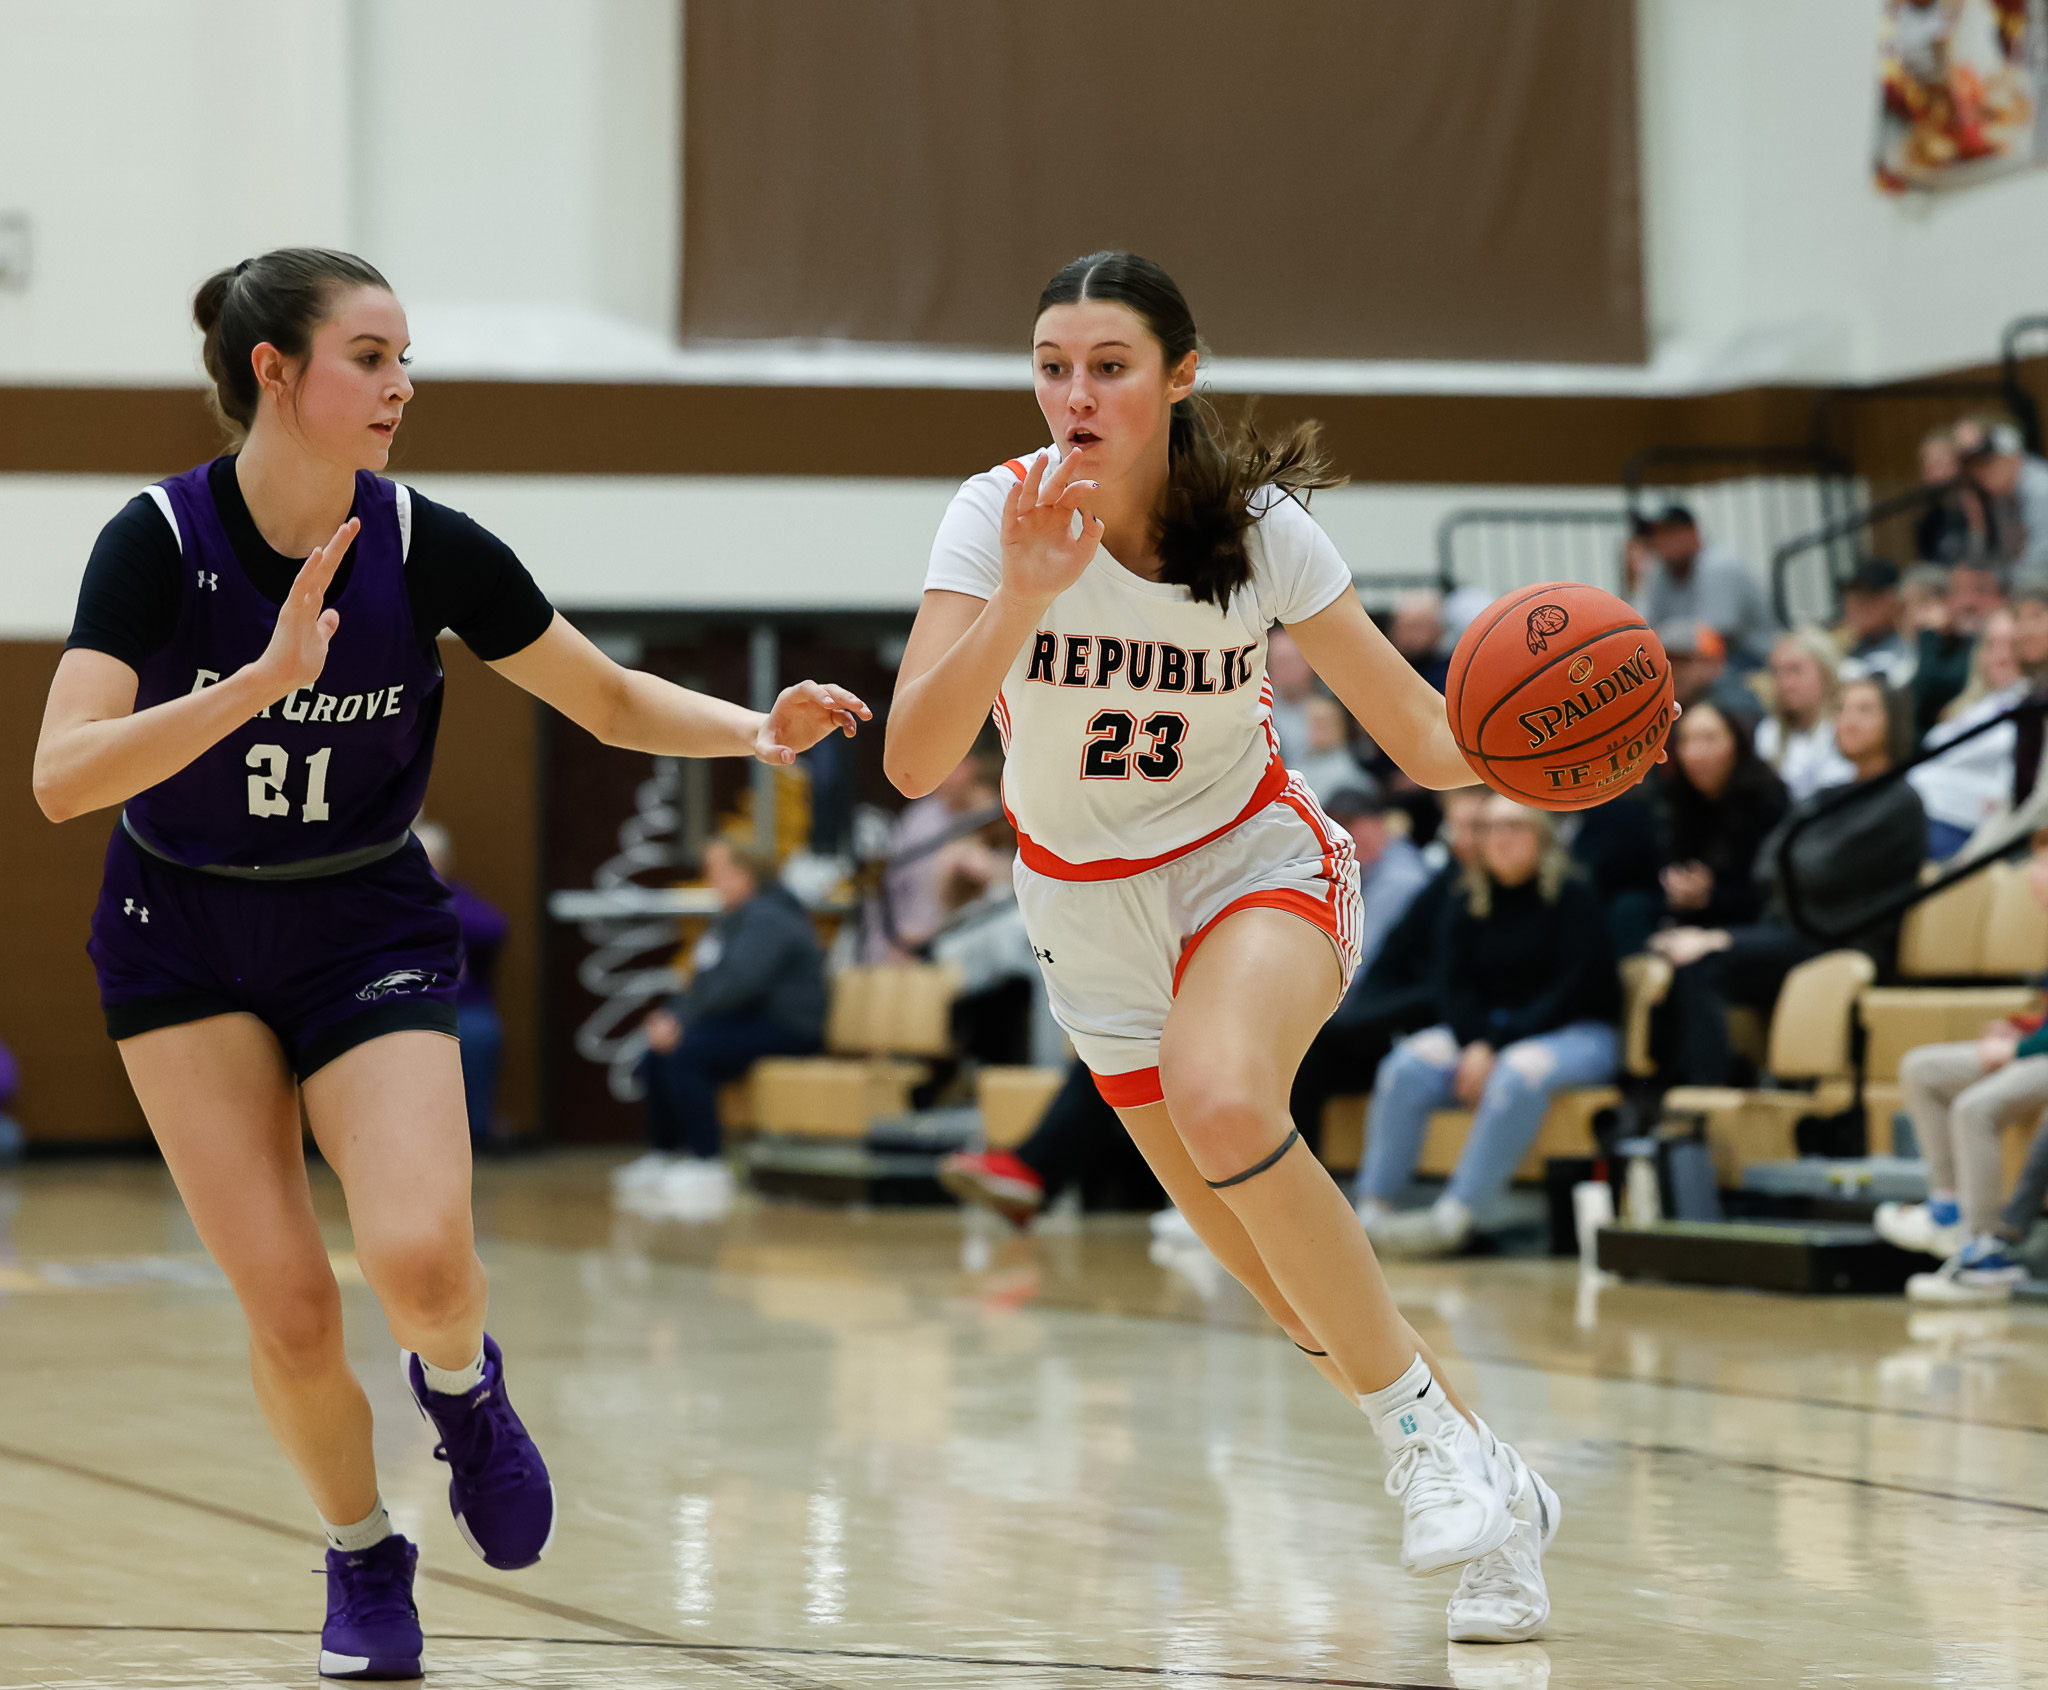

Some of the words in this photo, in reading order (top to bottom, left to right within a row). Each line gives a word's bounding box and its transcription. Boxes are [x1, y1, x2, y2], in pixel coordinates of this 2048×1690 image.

[1025, 629, 1259, 695] REPUBLIC
[1518, 645, 1658, 749] SPALDING
[281, 681, 405, 724] GROVE
[245, 743, 332, 823] 21
[1080, 709, 1190, 782] 23
[1544, 707, 1669, 787] TF-1000
